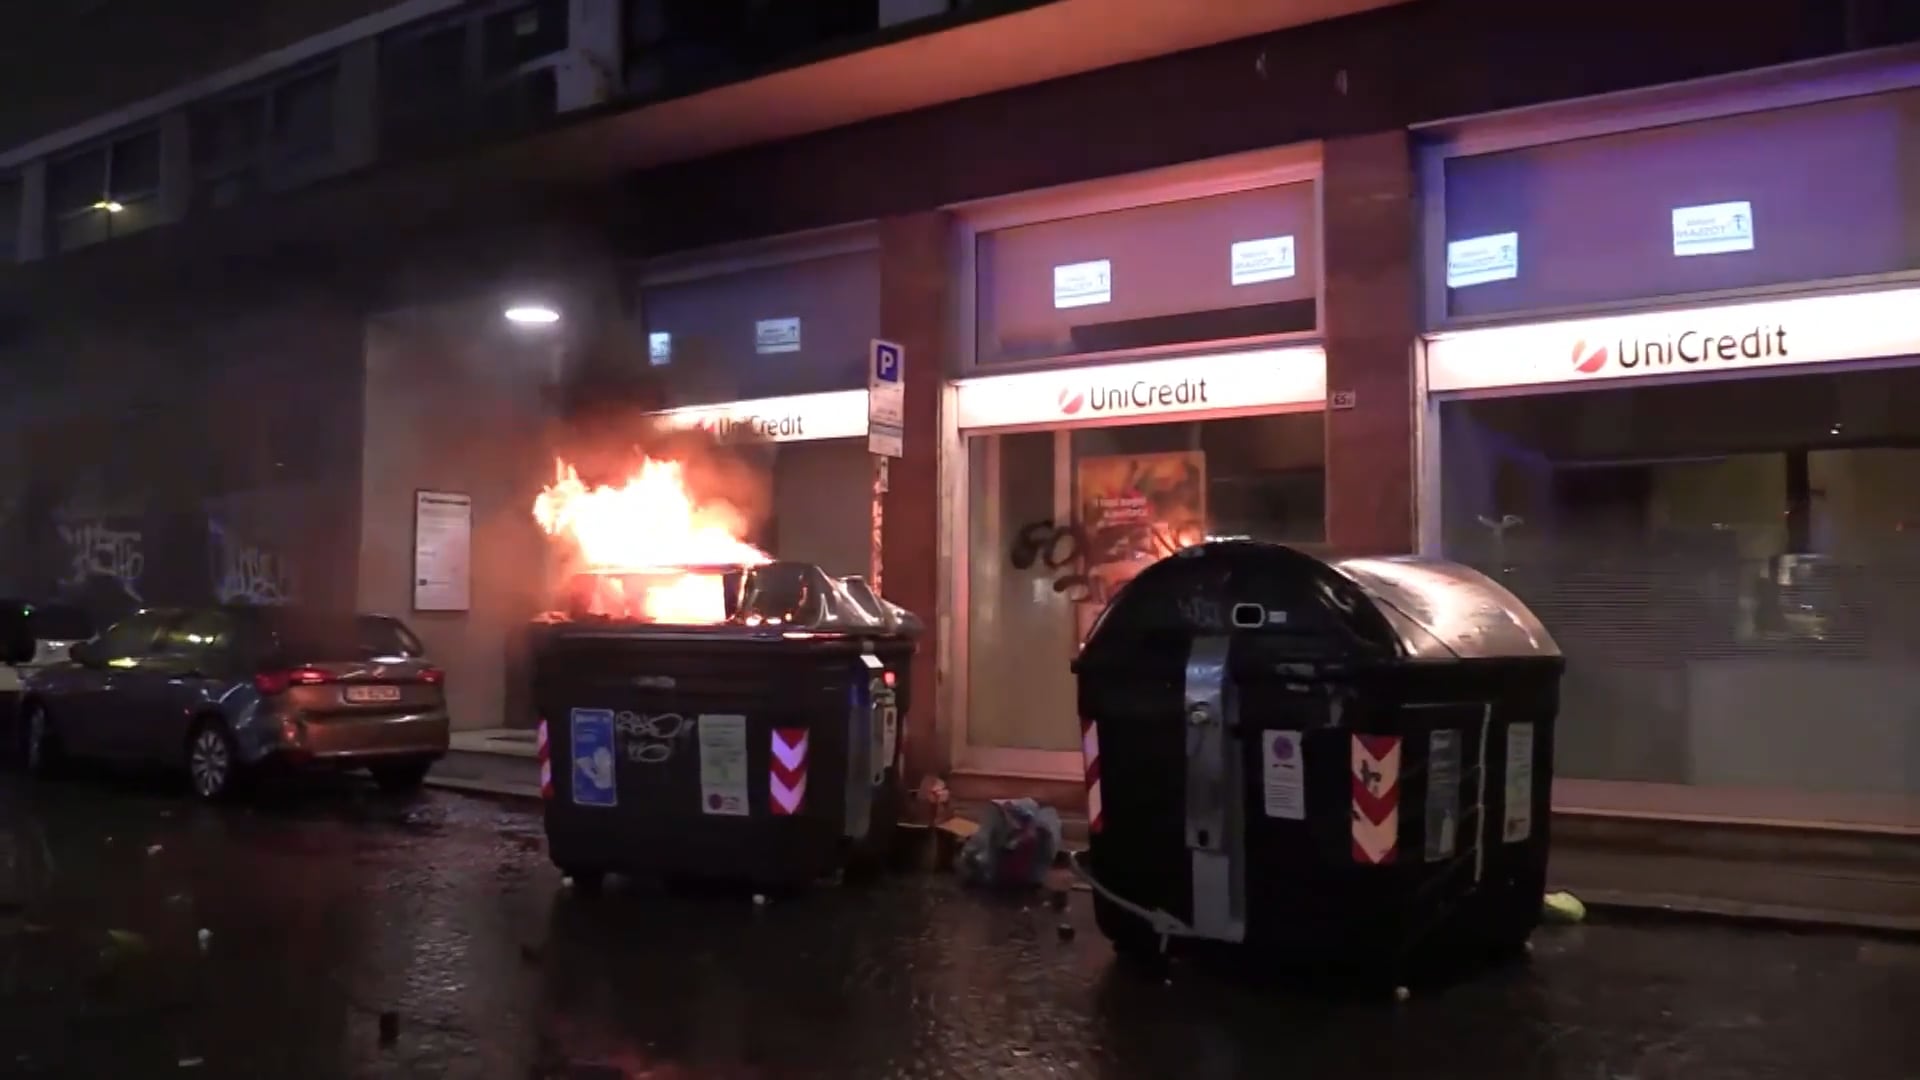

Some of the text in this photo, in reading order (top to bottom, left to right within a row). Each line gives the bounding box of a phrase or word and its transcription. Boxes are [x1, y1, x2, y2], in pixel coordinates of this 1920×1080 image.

[1618, 324, 1788, 368] UniCredit
[881, 350, 894, 375] P
[1090, 378, 1208, 410] UniCredit
